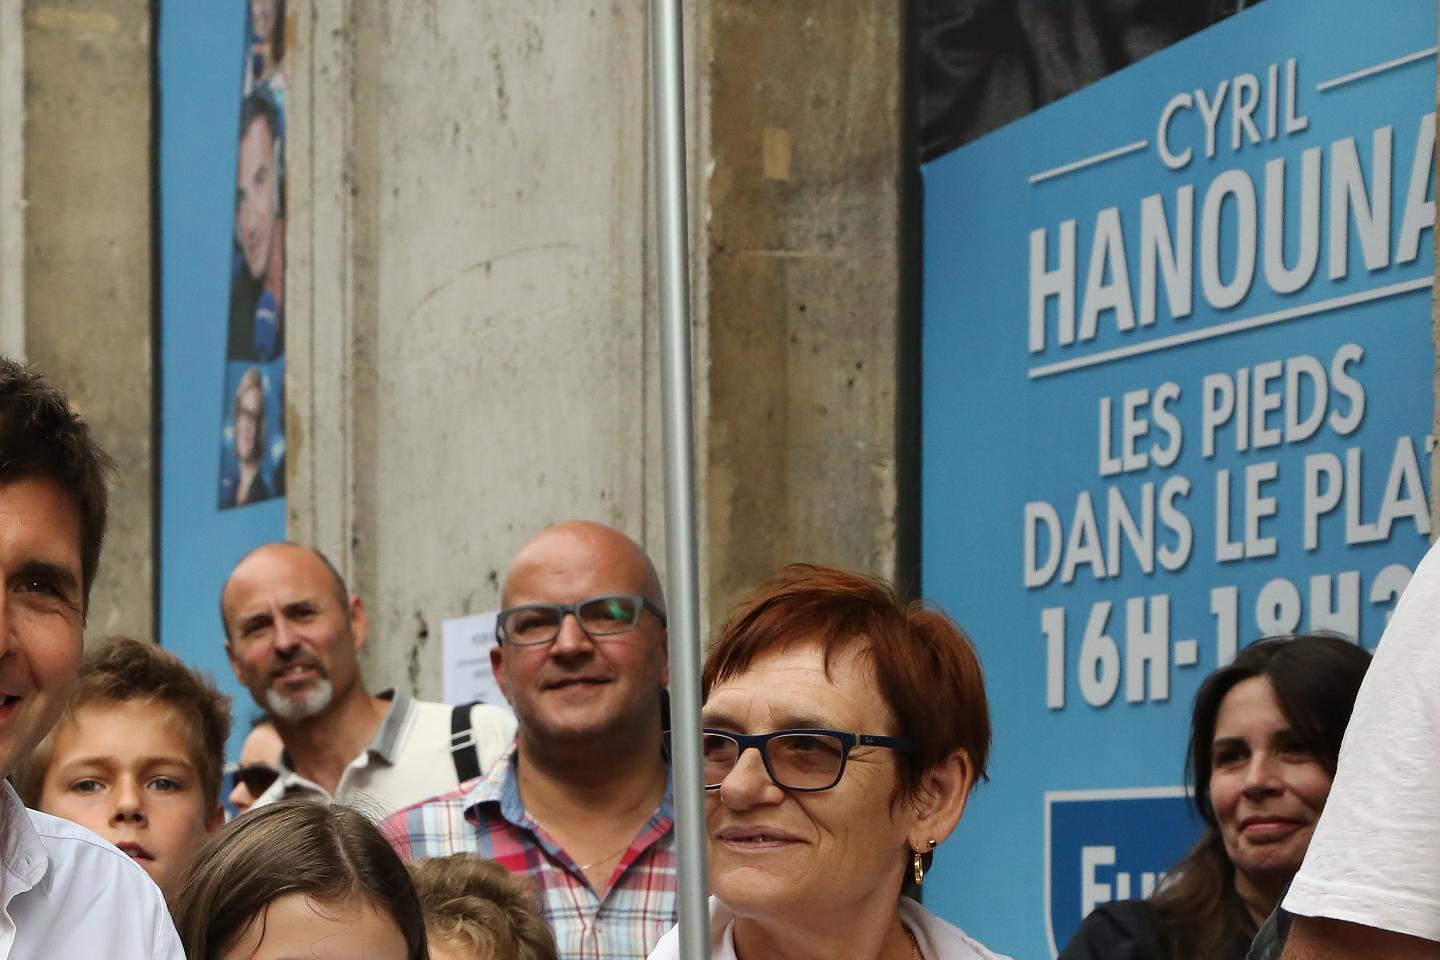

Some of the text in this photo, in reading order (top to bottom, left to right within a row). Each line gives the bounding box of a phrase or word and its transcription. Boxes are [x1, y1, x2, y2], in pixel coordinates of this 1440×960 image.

[1157, 57, 1308, 170] CYRIL
[1099, 343, 1365, 477] LES PIEDS
[1024, 434, 1434, 589] DANS LE PLA
